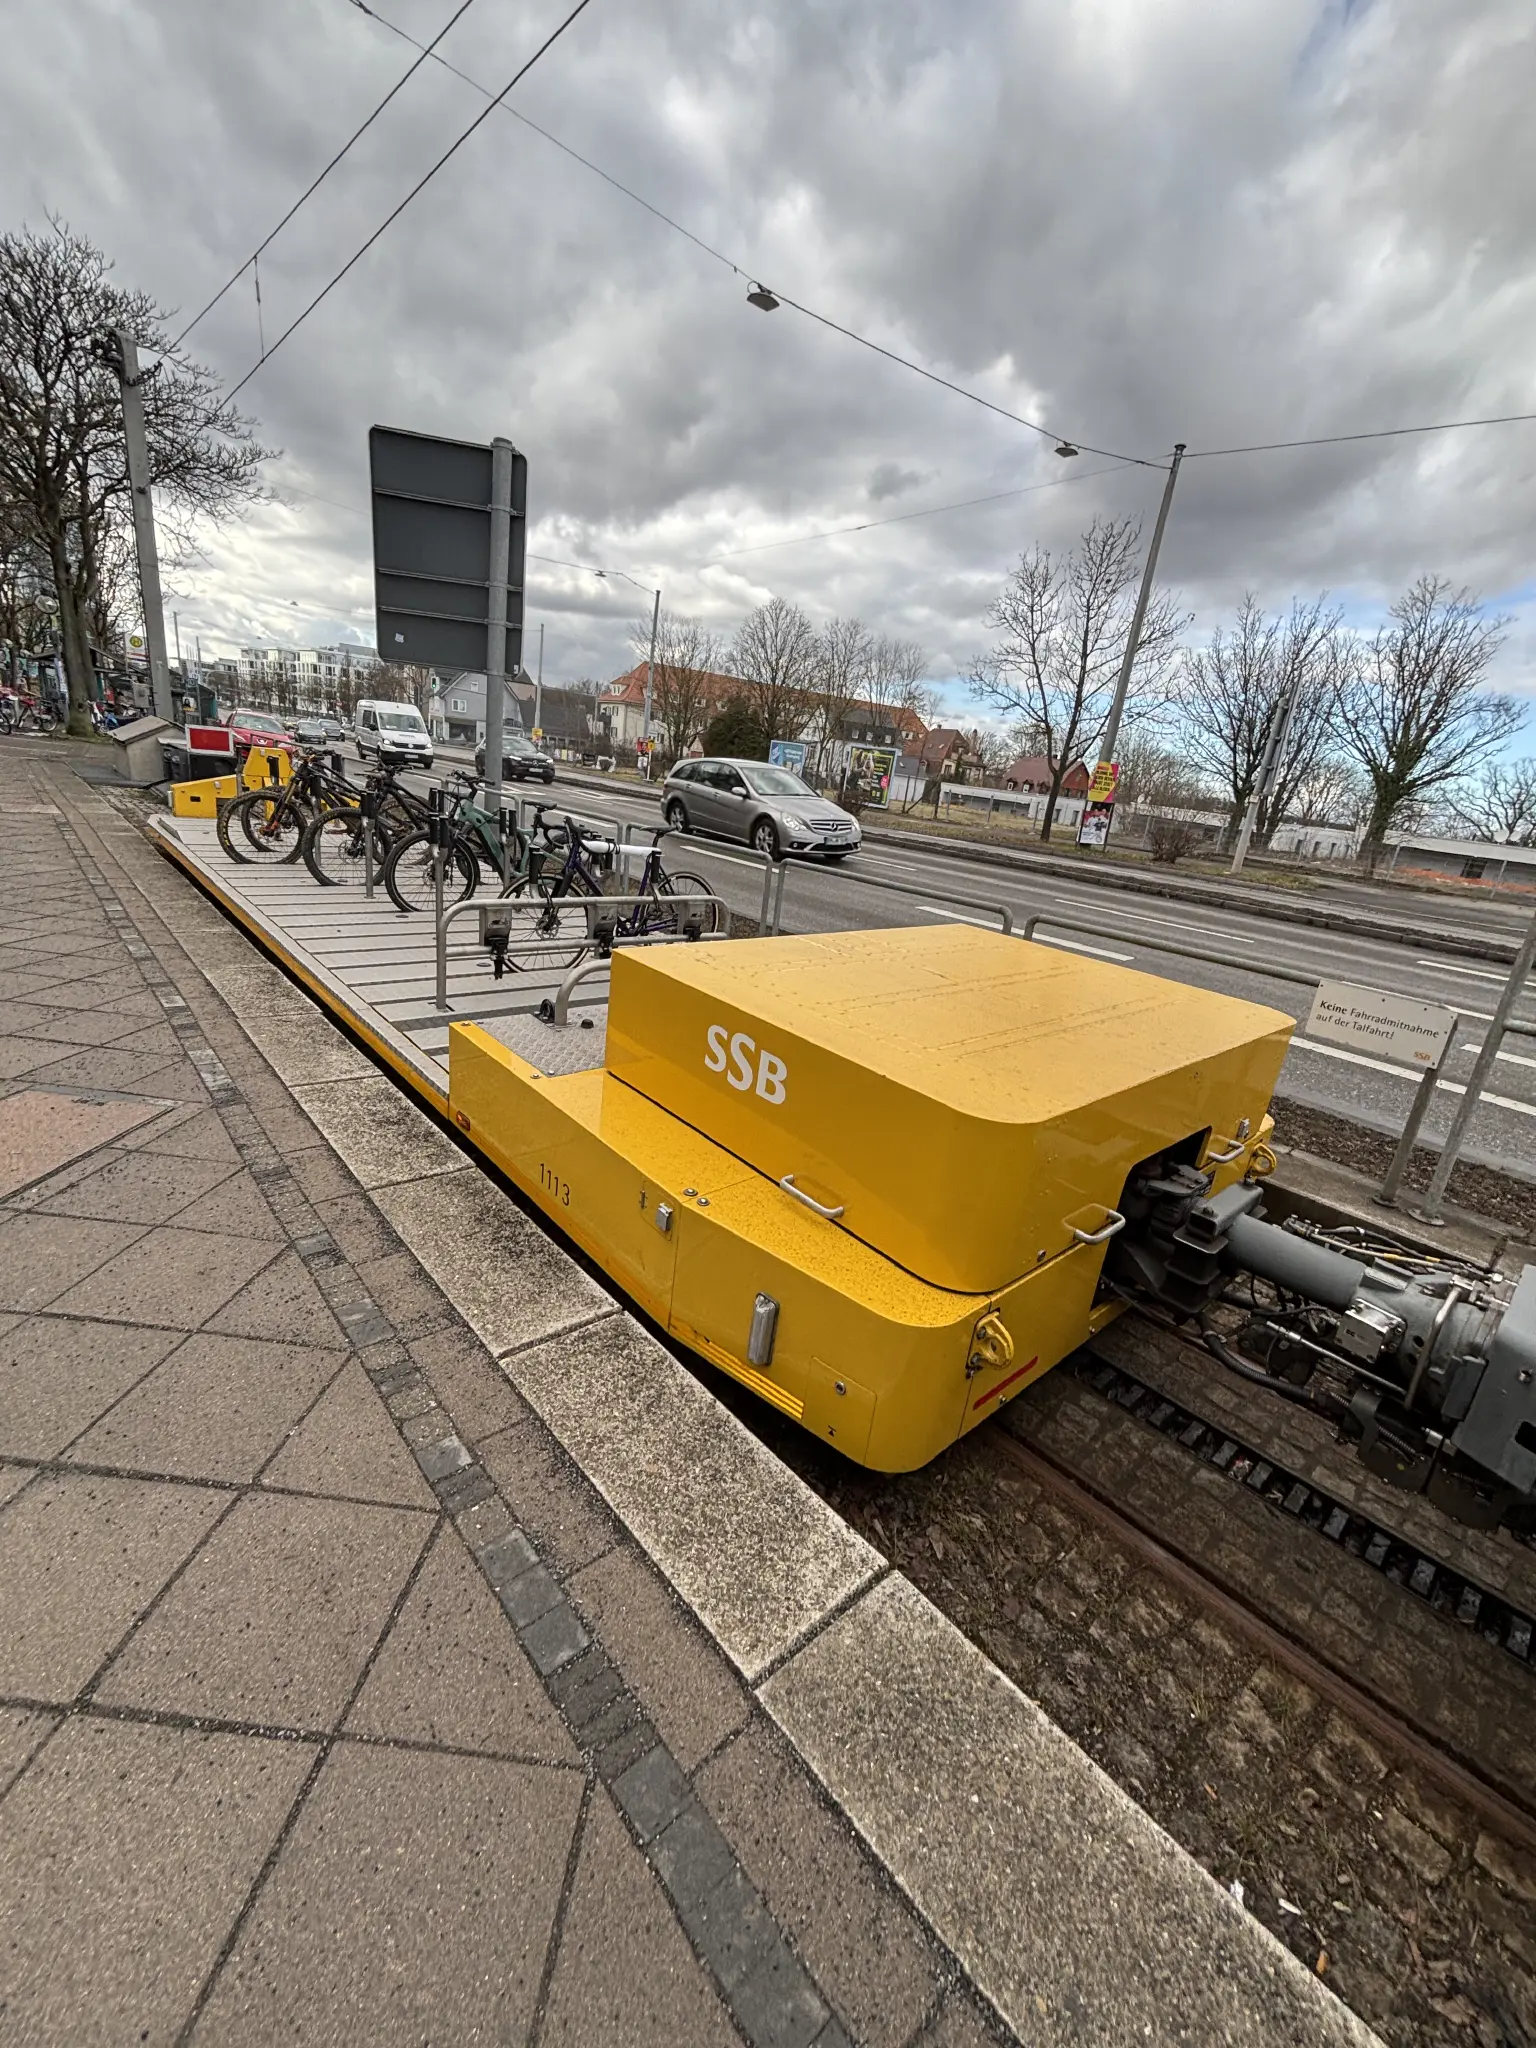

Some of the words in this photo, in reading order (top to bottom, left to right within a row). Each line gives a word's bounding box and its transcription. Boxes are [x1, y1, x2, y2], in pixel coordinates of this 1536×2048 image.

[1316, 1013, 1333, 1022] auf
[1334, 1017, 1350, 1028] der
[1352, 1021, 1395, 1040] Talfahrt!
[1320, 1000, 1348, 1015] Keine
[1350, 1008, 1440, 1039] Fahrradmitnahme
[704, 1024, 788, 1105] SSB
[540, 1163, 570, 1206] 1113
